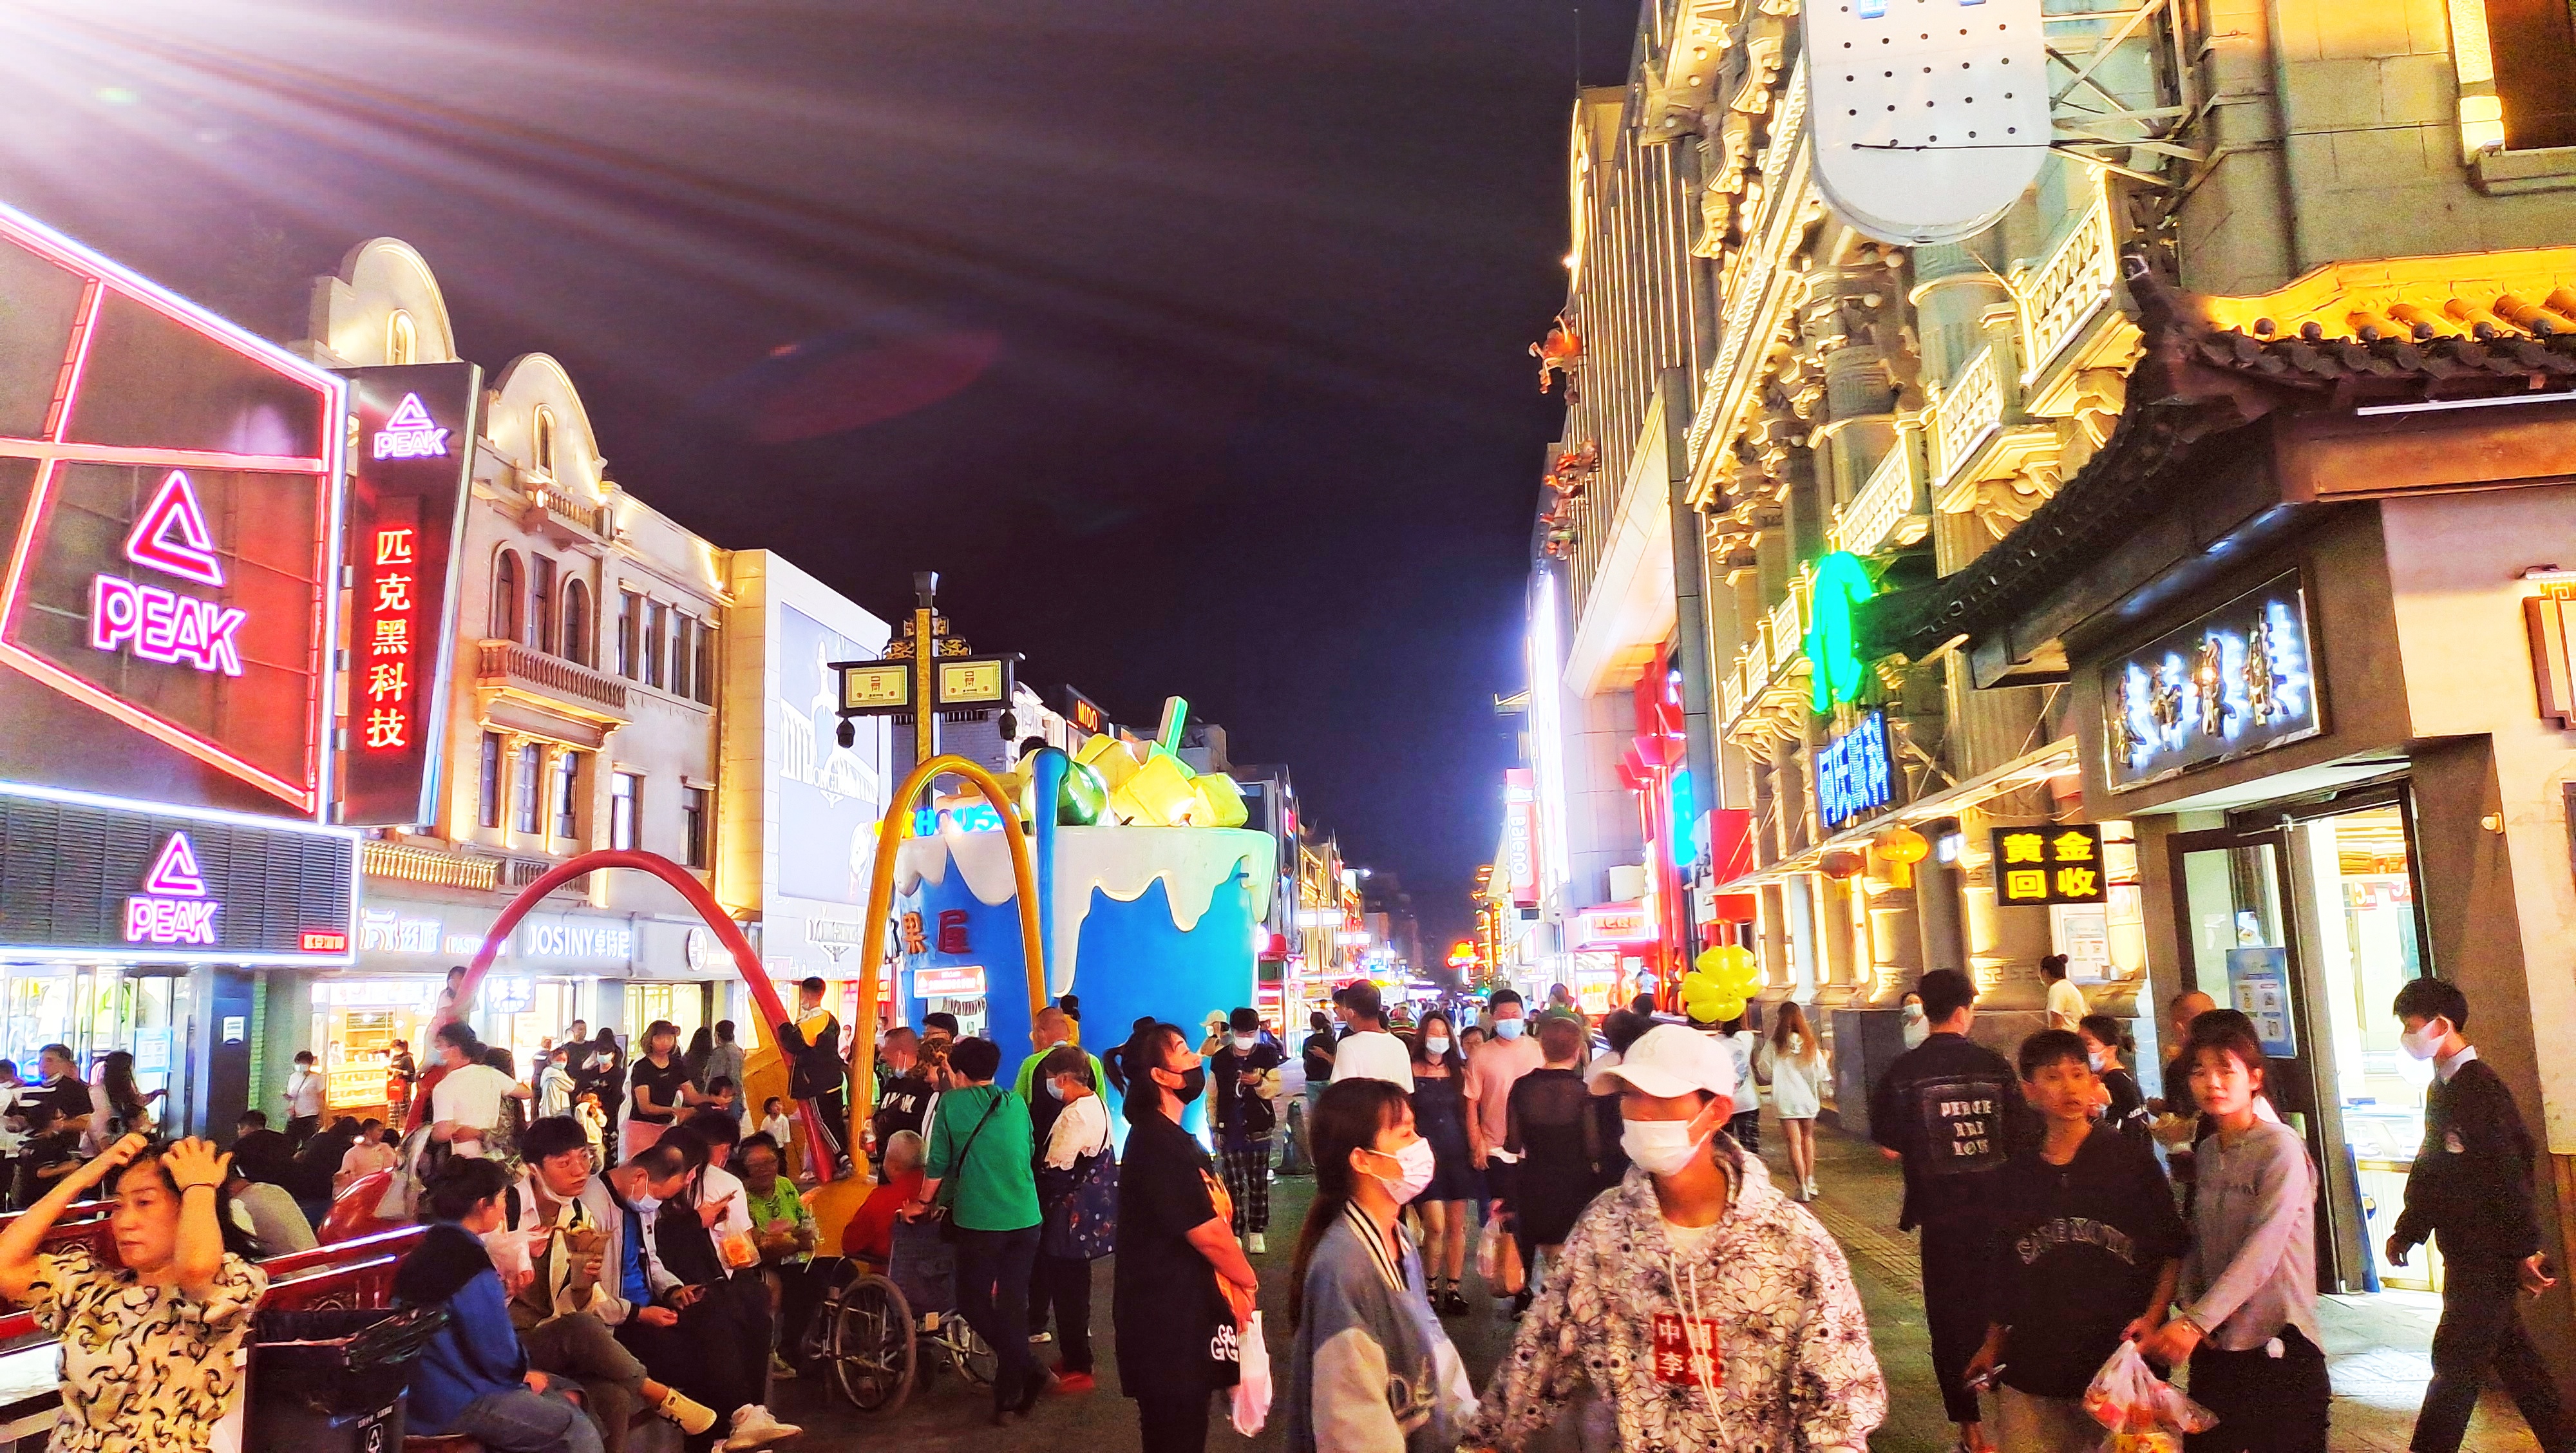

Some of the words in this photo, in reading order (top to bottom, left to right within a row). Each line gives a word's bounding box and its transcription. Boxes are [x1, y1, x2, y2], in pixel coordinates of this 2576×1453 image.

[372, 427, 448, 460] PEAK
[92, 573, 247, 678] PEAK
[366, 528, 415, 748] 匹克黑科技
[1077, 699, 1098, 733] MIDO
[1510, 815, 1528, 875] Baleno
[2003, 831, 2094, 864] 黄金
[2007, 867, 2098, 900] 回收
[126, 897, 220, 944] PEAK
[527, 925, 594, 957] JOSINY
